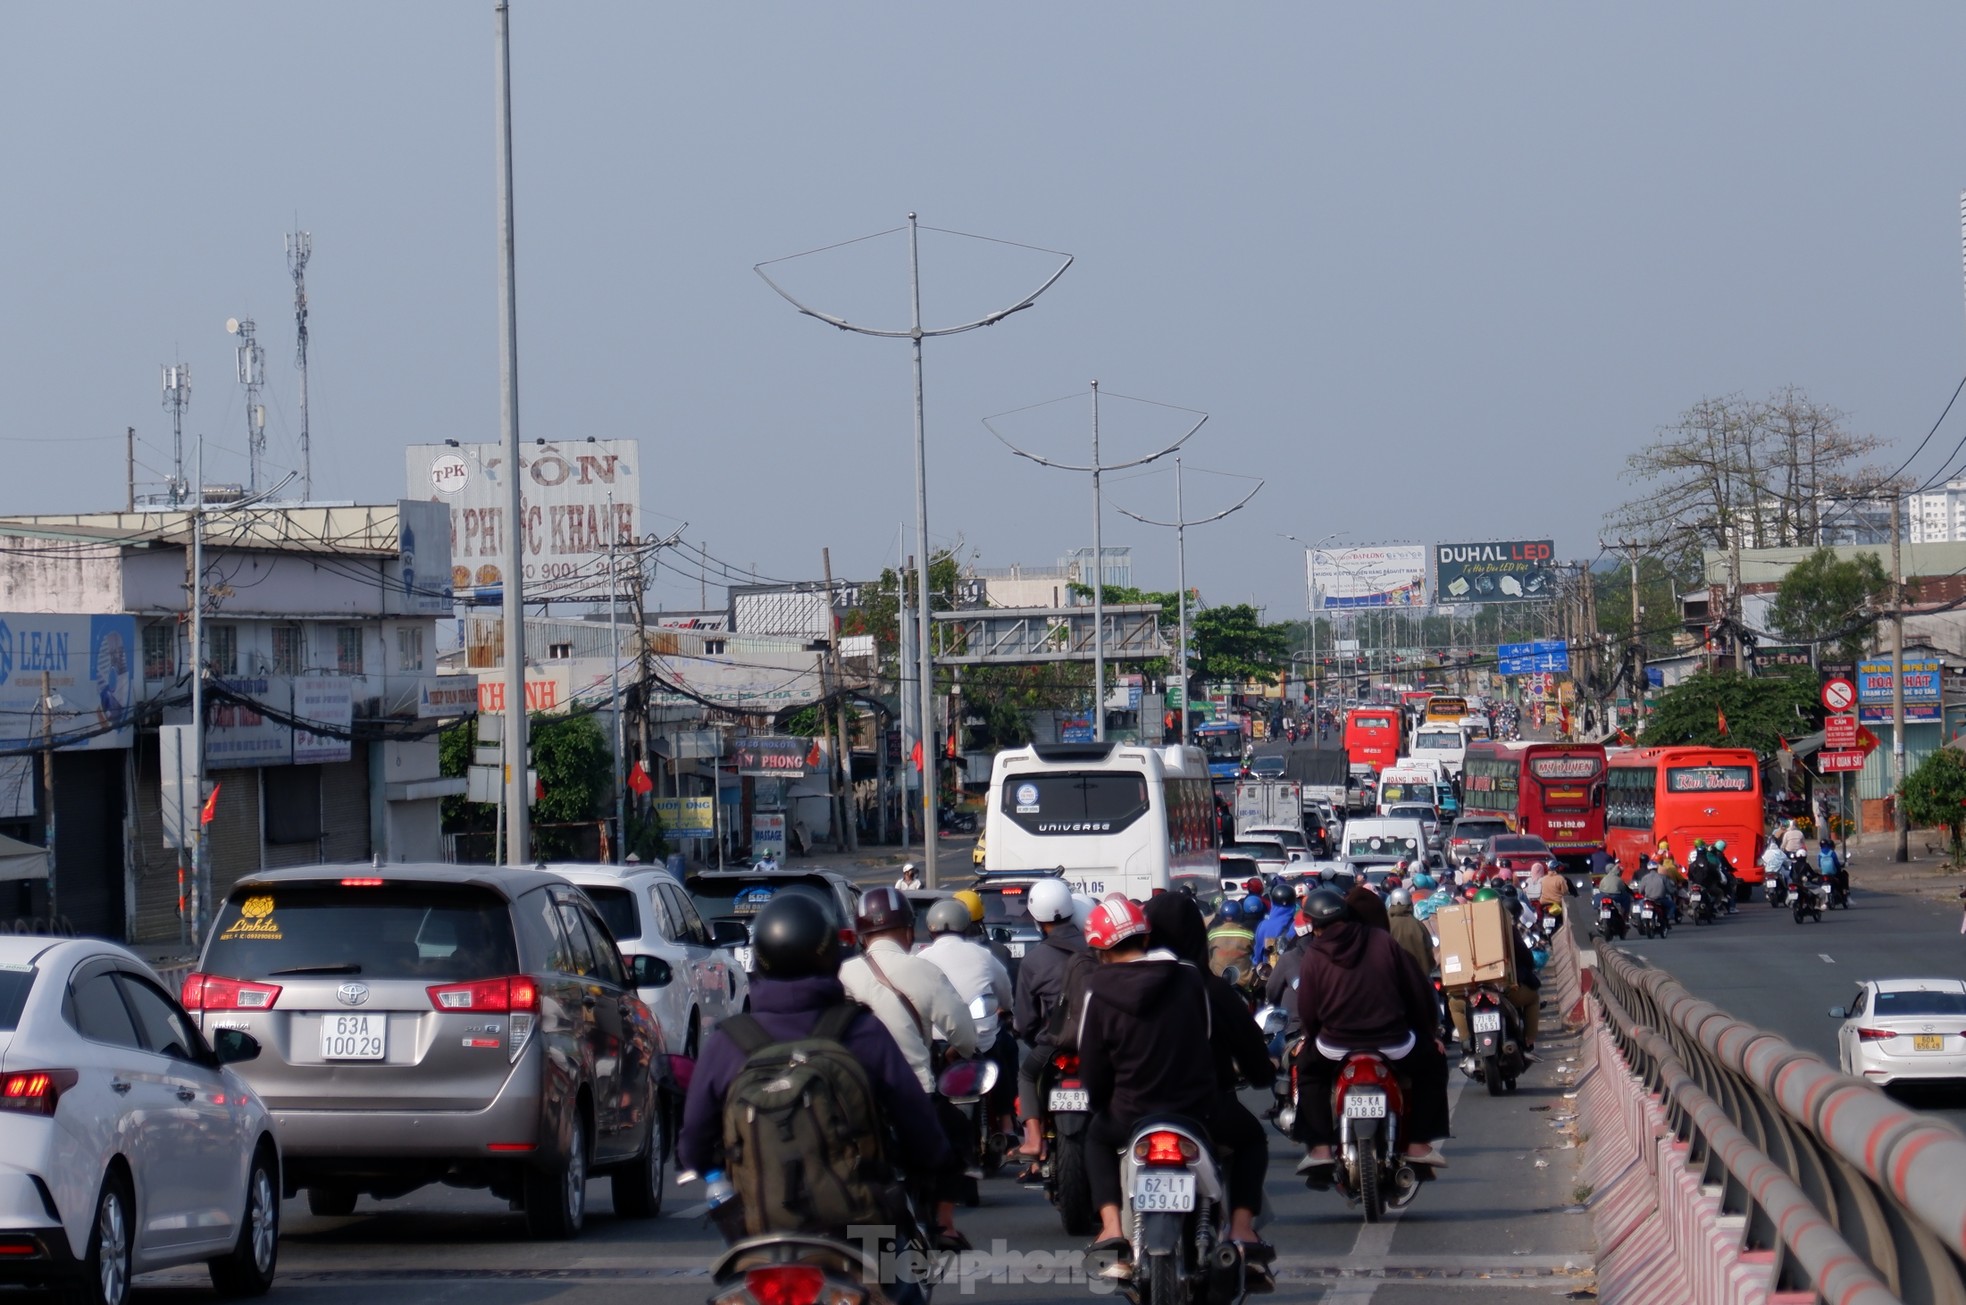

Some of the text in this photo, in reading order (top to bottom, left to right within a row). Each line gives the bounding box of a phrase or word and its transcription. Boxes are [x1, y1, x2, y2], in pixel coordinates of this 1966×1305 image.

[433, 464, 465, 483] TPK
[1441, 543, 1550, 563] DUHAL LED
[541, 562, 579, 579] 9001
[20, 631, 69, 671] LEAN
[478, 680, 556, 711] THNH
[761, 754, 803, 768] PHONG
[1675, 774, 1703, 789] Kim
[1039, 823, 1110, 831] UNIVERSE
[755, 830, 782, 841] MASSAGE
[337, 1016, 369, 1036] 63A
[325, 1037, 382, 1056] 100.29
[1351, 1096, 1380, 1107] 59-KA
[1346, 1106, 1384, 1117] 018.85
[1144, 1178, 1185, 1193] 62-L1
[1137, 1194, 1191, 1210] 959.40
